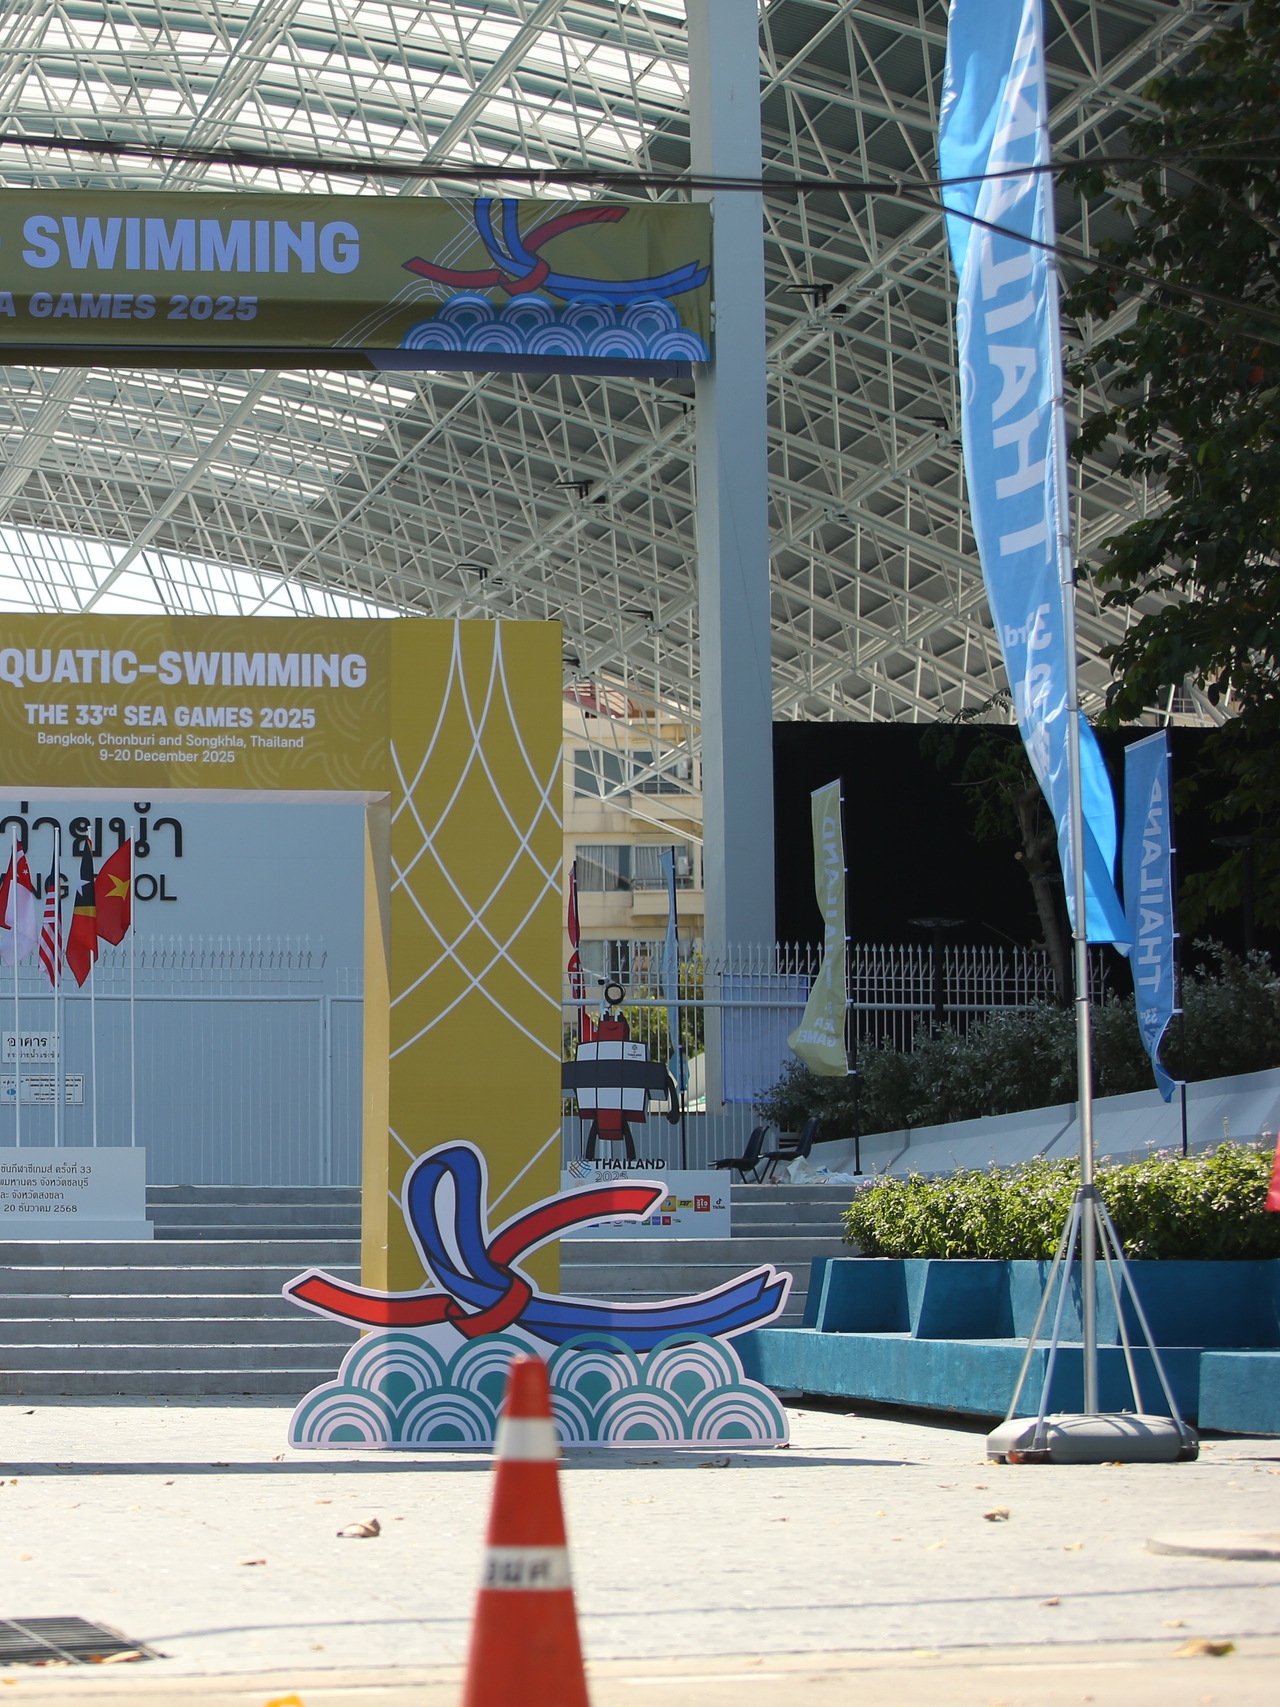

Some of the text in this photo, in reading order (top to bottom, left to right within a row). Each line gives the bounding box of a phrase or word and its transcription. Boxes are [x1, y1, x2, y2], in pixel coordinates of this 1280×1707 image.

[22, 215, 360, 274] SWIMMING
[28, 292, 156, 320] GAMES
[167, 295, 258, 321] 2025
[25, 704, 316, 729] THE 33rd SEA GAMES 2025
[37, 732, 303, 749] Bangkok, Chonburi and Songkhla, Thailand
[99, 749, 235, 763] 9-20 December 2025
[55, 1162, 77, 1174] ครั้งที่
[80, 1165, 92, 1174] 33
[594, 1158, 665, 1170] THAILAND
[595, 1171, 628, 1182] 2025
[40, 1177, 89, 1189] จังหวัดชลบุรี
[12, 1189, 64, 1200] จังหวัดสงขลา
[4, 1204, 16, 1212] 20
[18, 1202, 51, 1212] ธันวาคม
[54, 1204, 77, 1213] 2568
